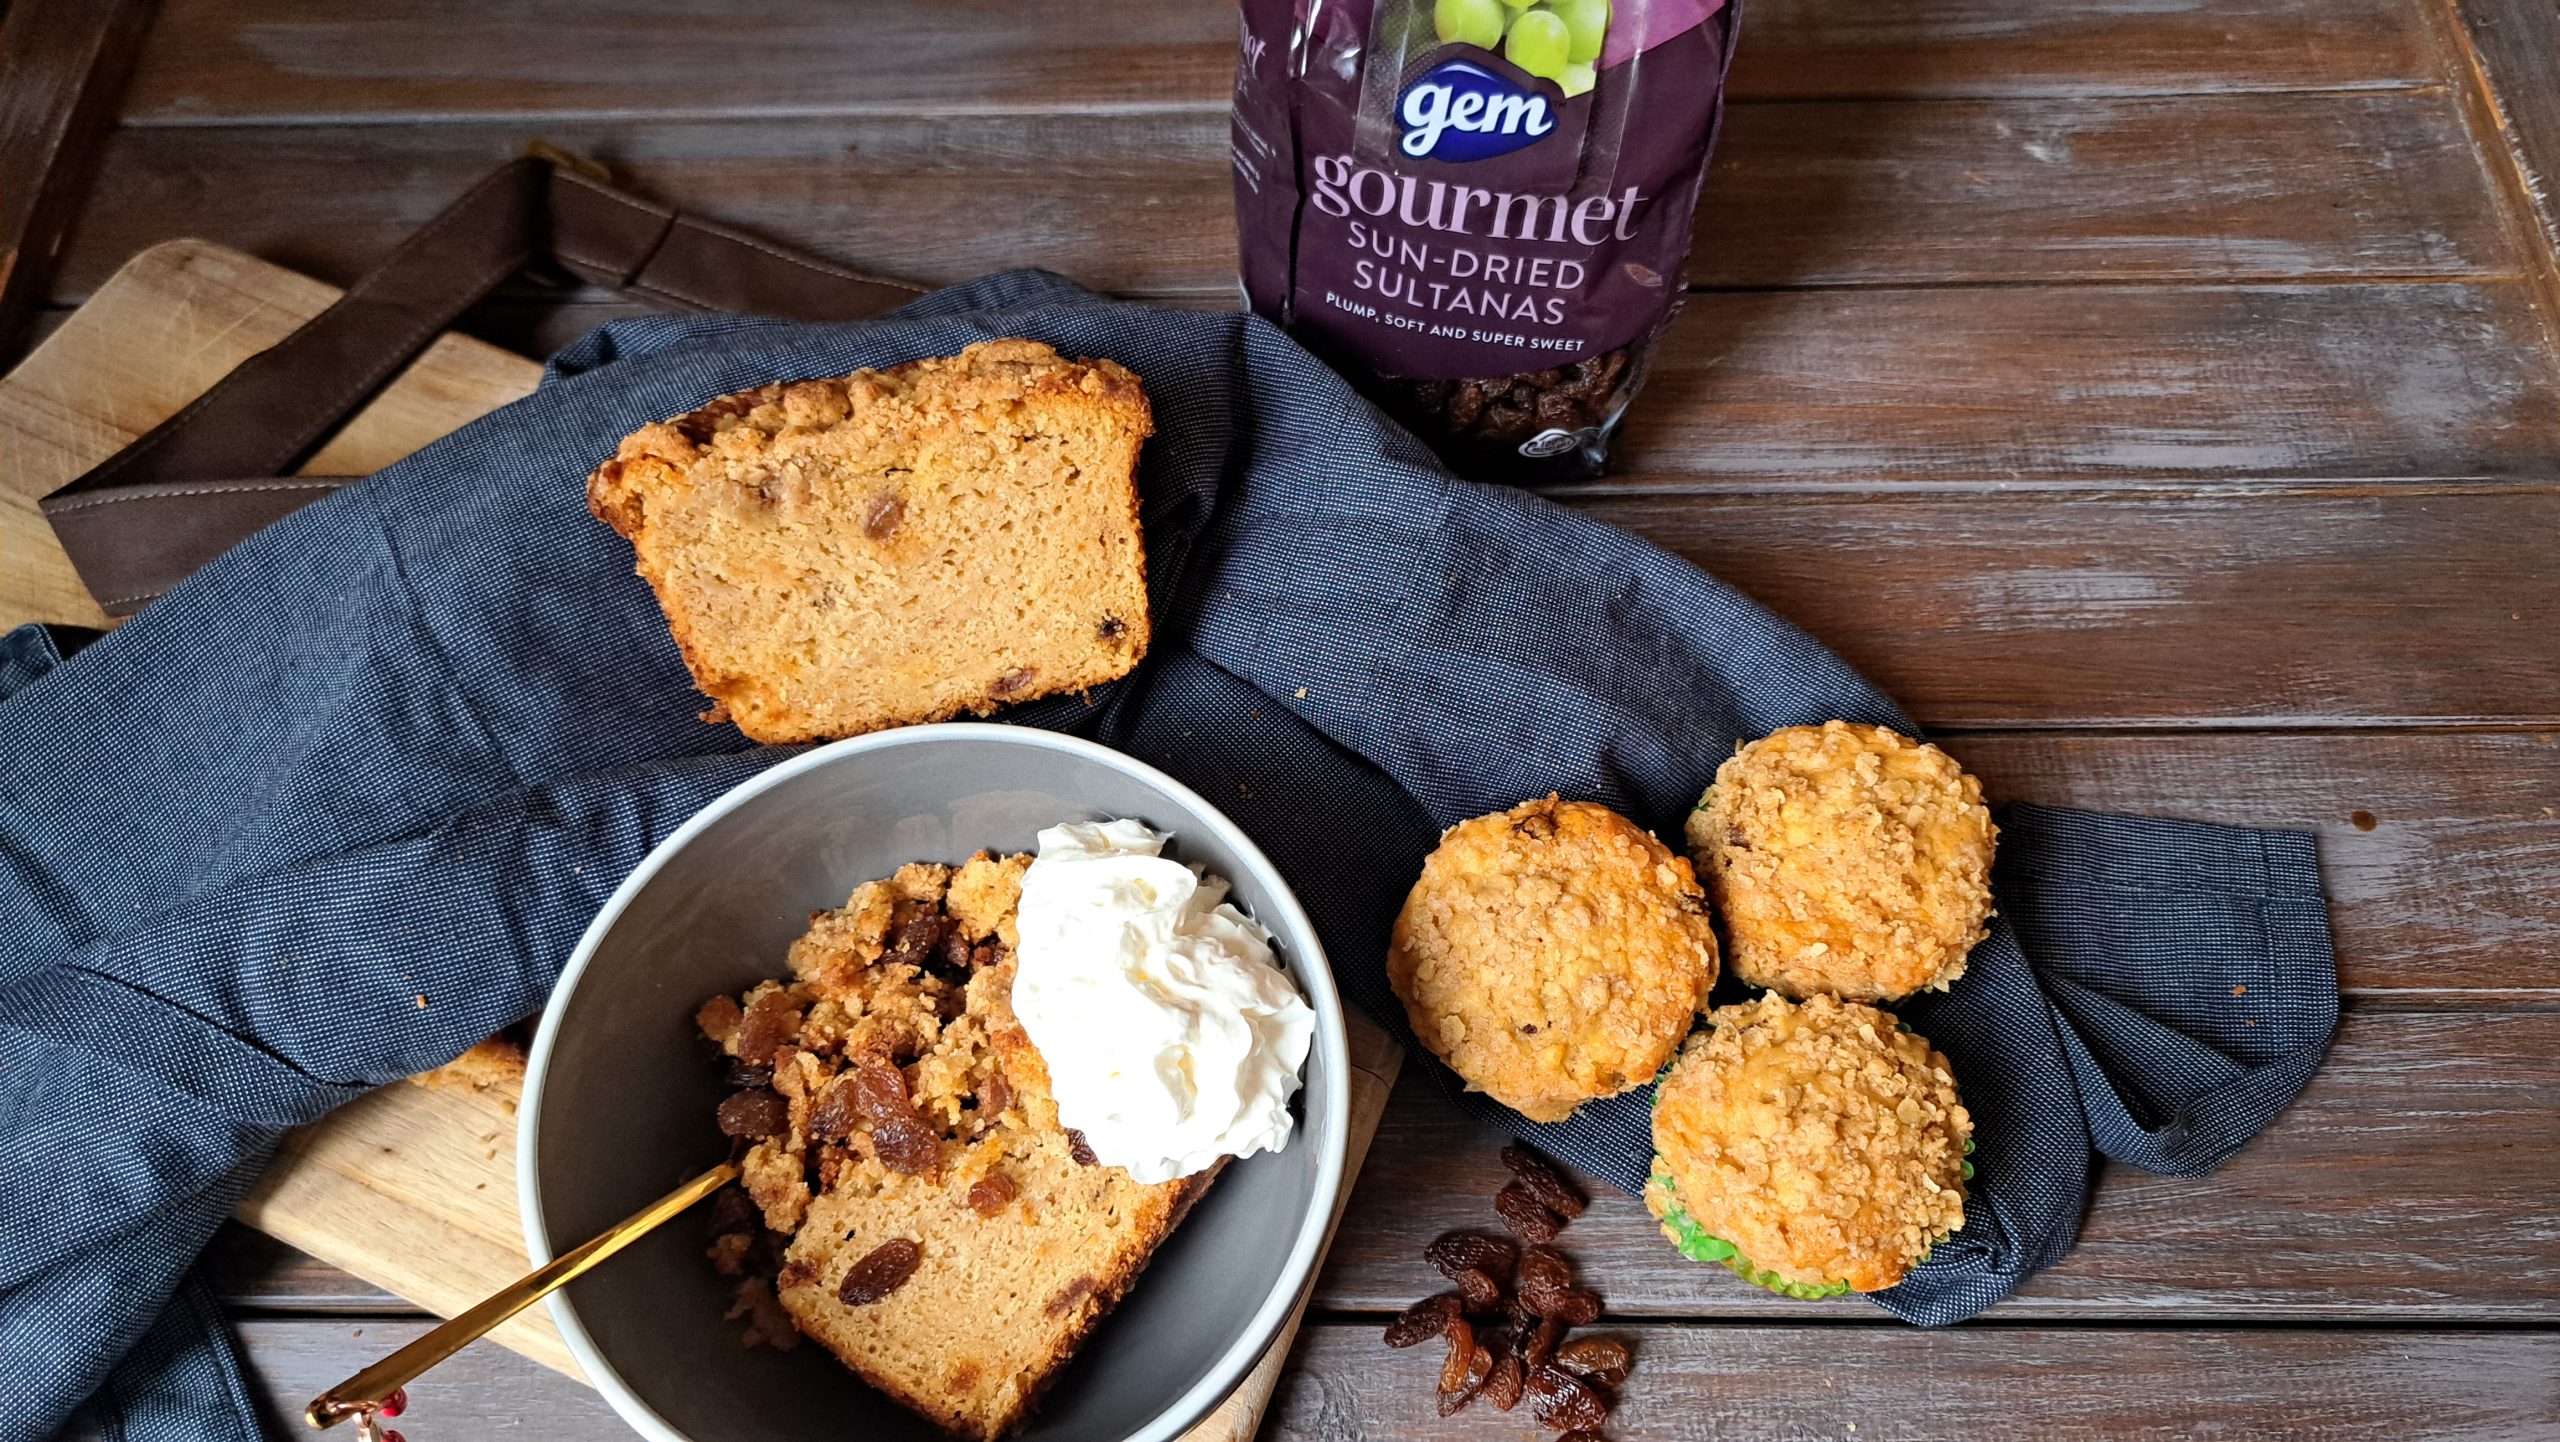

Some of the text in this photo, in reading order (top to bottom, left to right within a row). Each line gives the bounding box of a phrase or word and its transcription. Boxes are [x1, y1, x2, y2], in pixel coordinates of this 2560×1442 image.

[1402, 82, 1552, 156] gem
[1312, 155, 1649, 246] gourmet
[1348, 220, 1585, 290] SUN-DRIED
[1326, 292, 1585, 352] PLUMP, SOFT AND SUPER SWEET
[1353, 260, 1566, 326] SULTANAS
